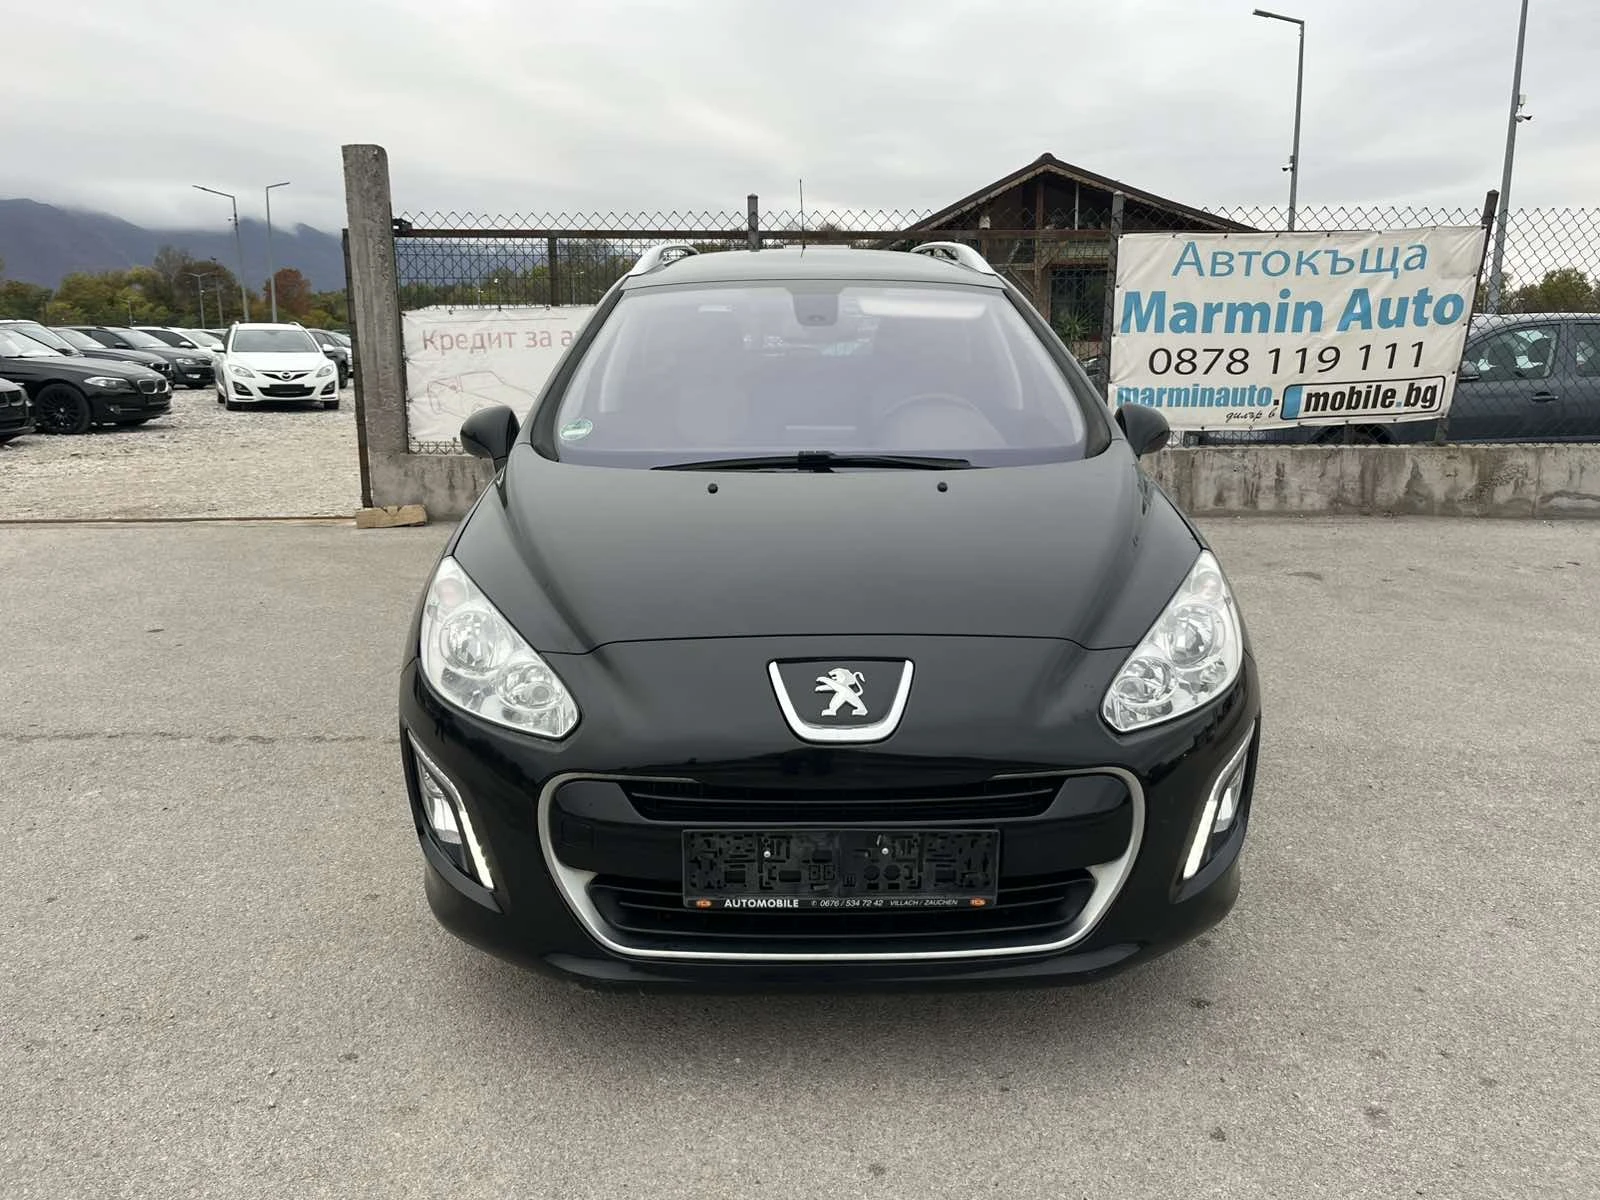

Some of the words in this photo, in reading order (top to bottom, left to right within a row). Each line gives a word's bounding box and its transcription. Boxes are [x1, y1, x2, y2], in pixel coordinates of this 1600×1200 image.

[1171, 241, 1428, 279] Автокъща
[1120, 288, 1324, 334] Marmin
[1336, 287, 1465, 333] Auto
[422, 329, 517, 355] Кредит
[525, 330, 552, 348] за
[561, 330, 574, 347] а
[1148, 347, 1250, 375] 0878
[1268, 346, 1341, 375] 119
[1359, 341, 1424, 371] 111
[1304, 382, 1438, 413] mobile.bg
[724, 899, 799, 908] AUTOMOBILE
